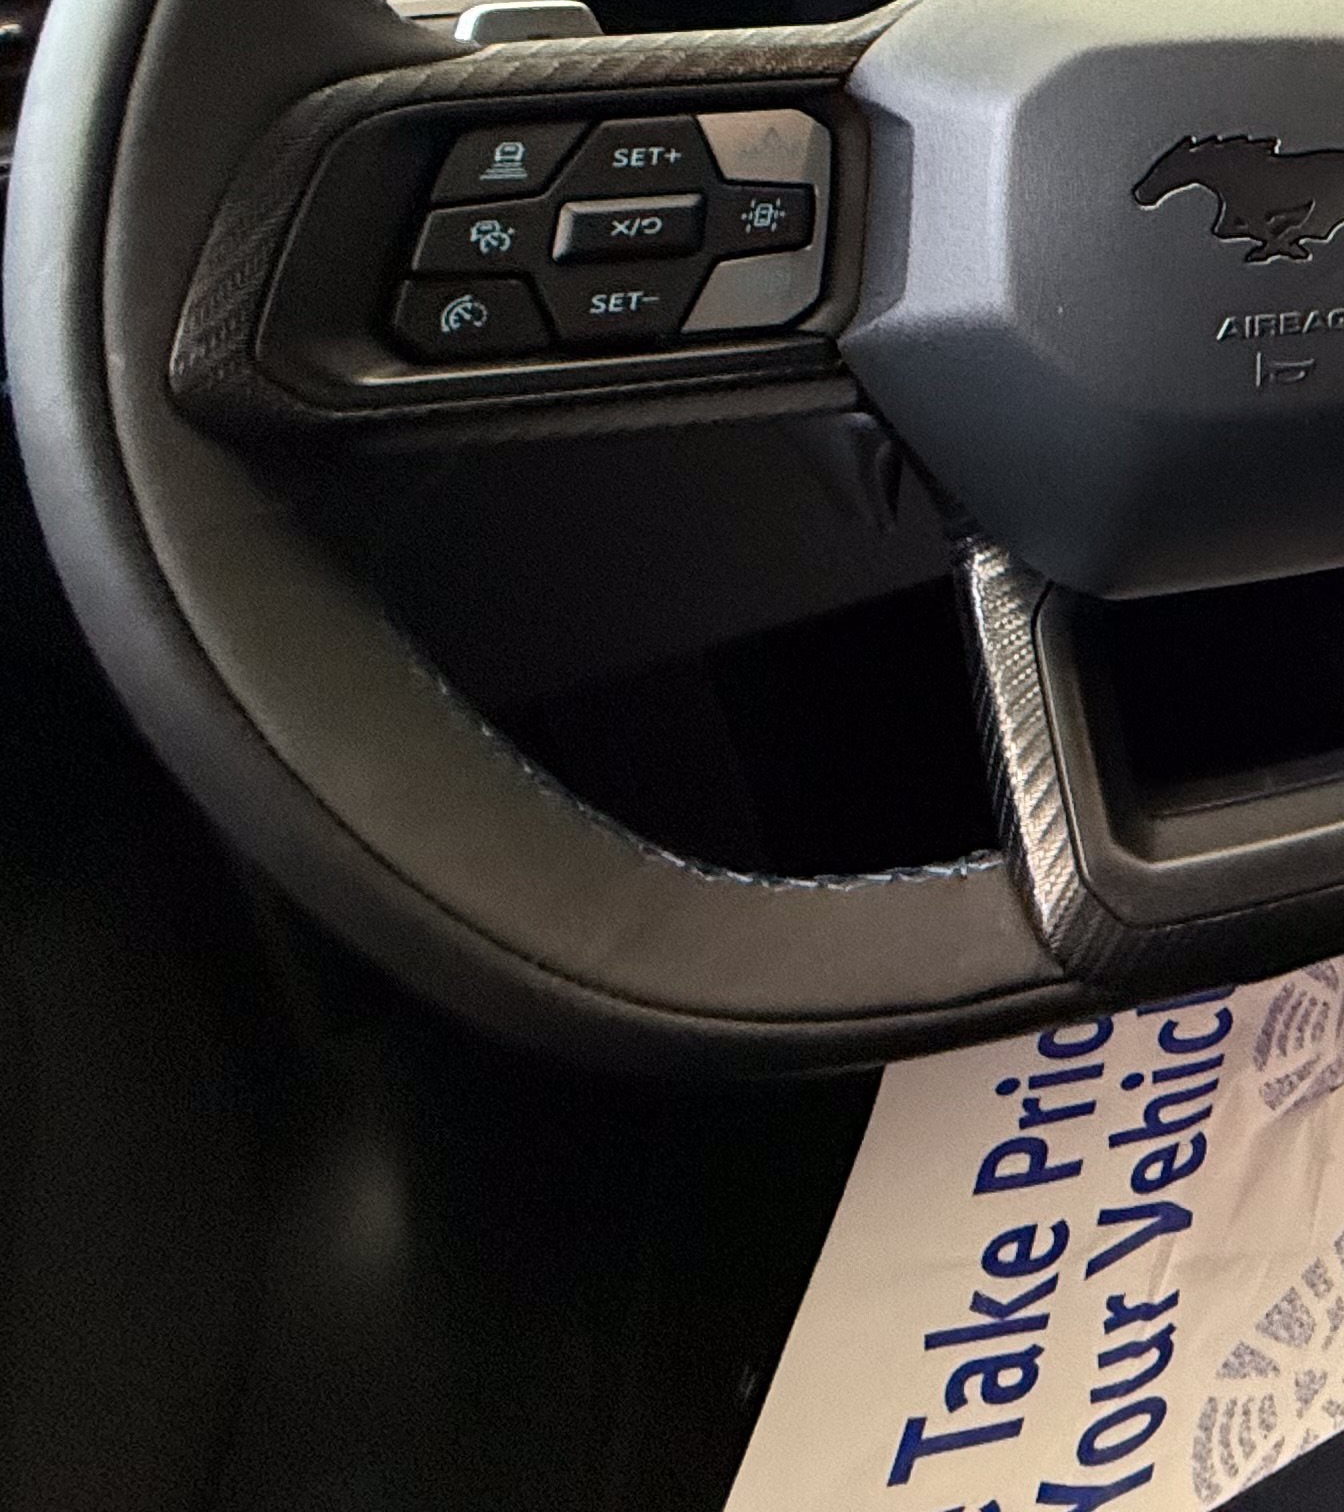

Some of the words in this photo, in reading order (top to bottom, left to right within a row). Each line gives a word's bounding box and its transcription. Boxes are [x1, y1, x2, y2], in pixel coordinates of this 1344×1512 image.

[612, 146, 682, 169] SET+
[887, 1219, 1070, 1487] Take
[1036, 1289, 1180, 1512] Your
